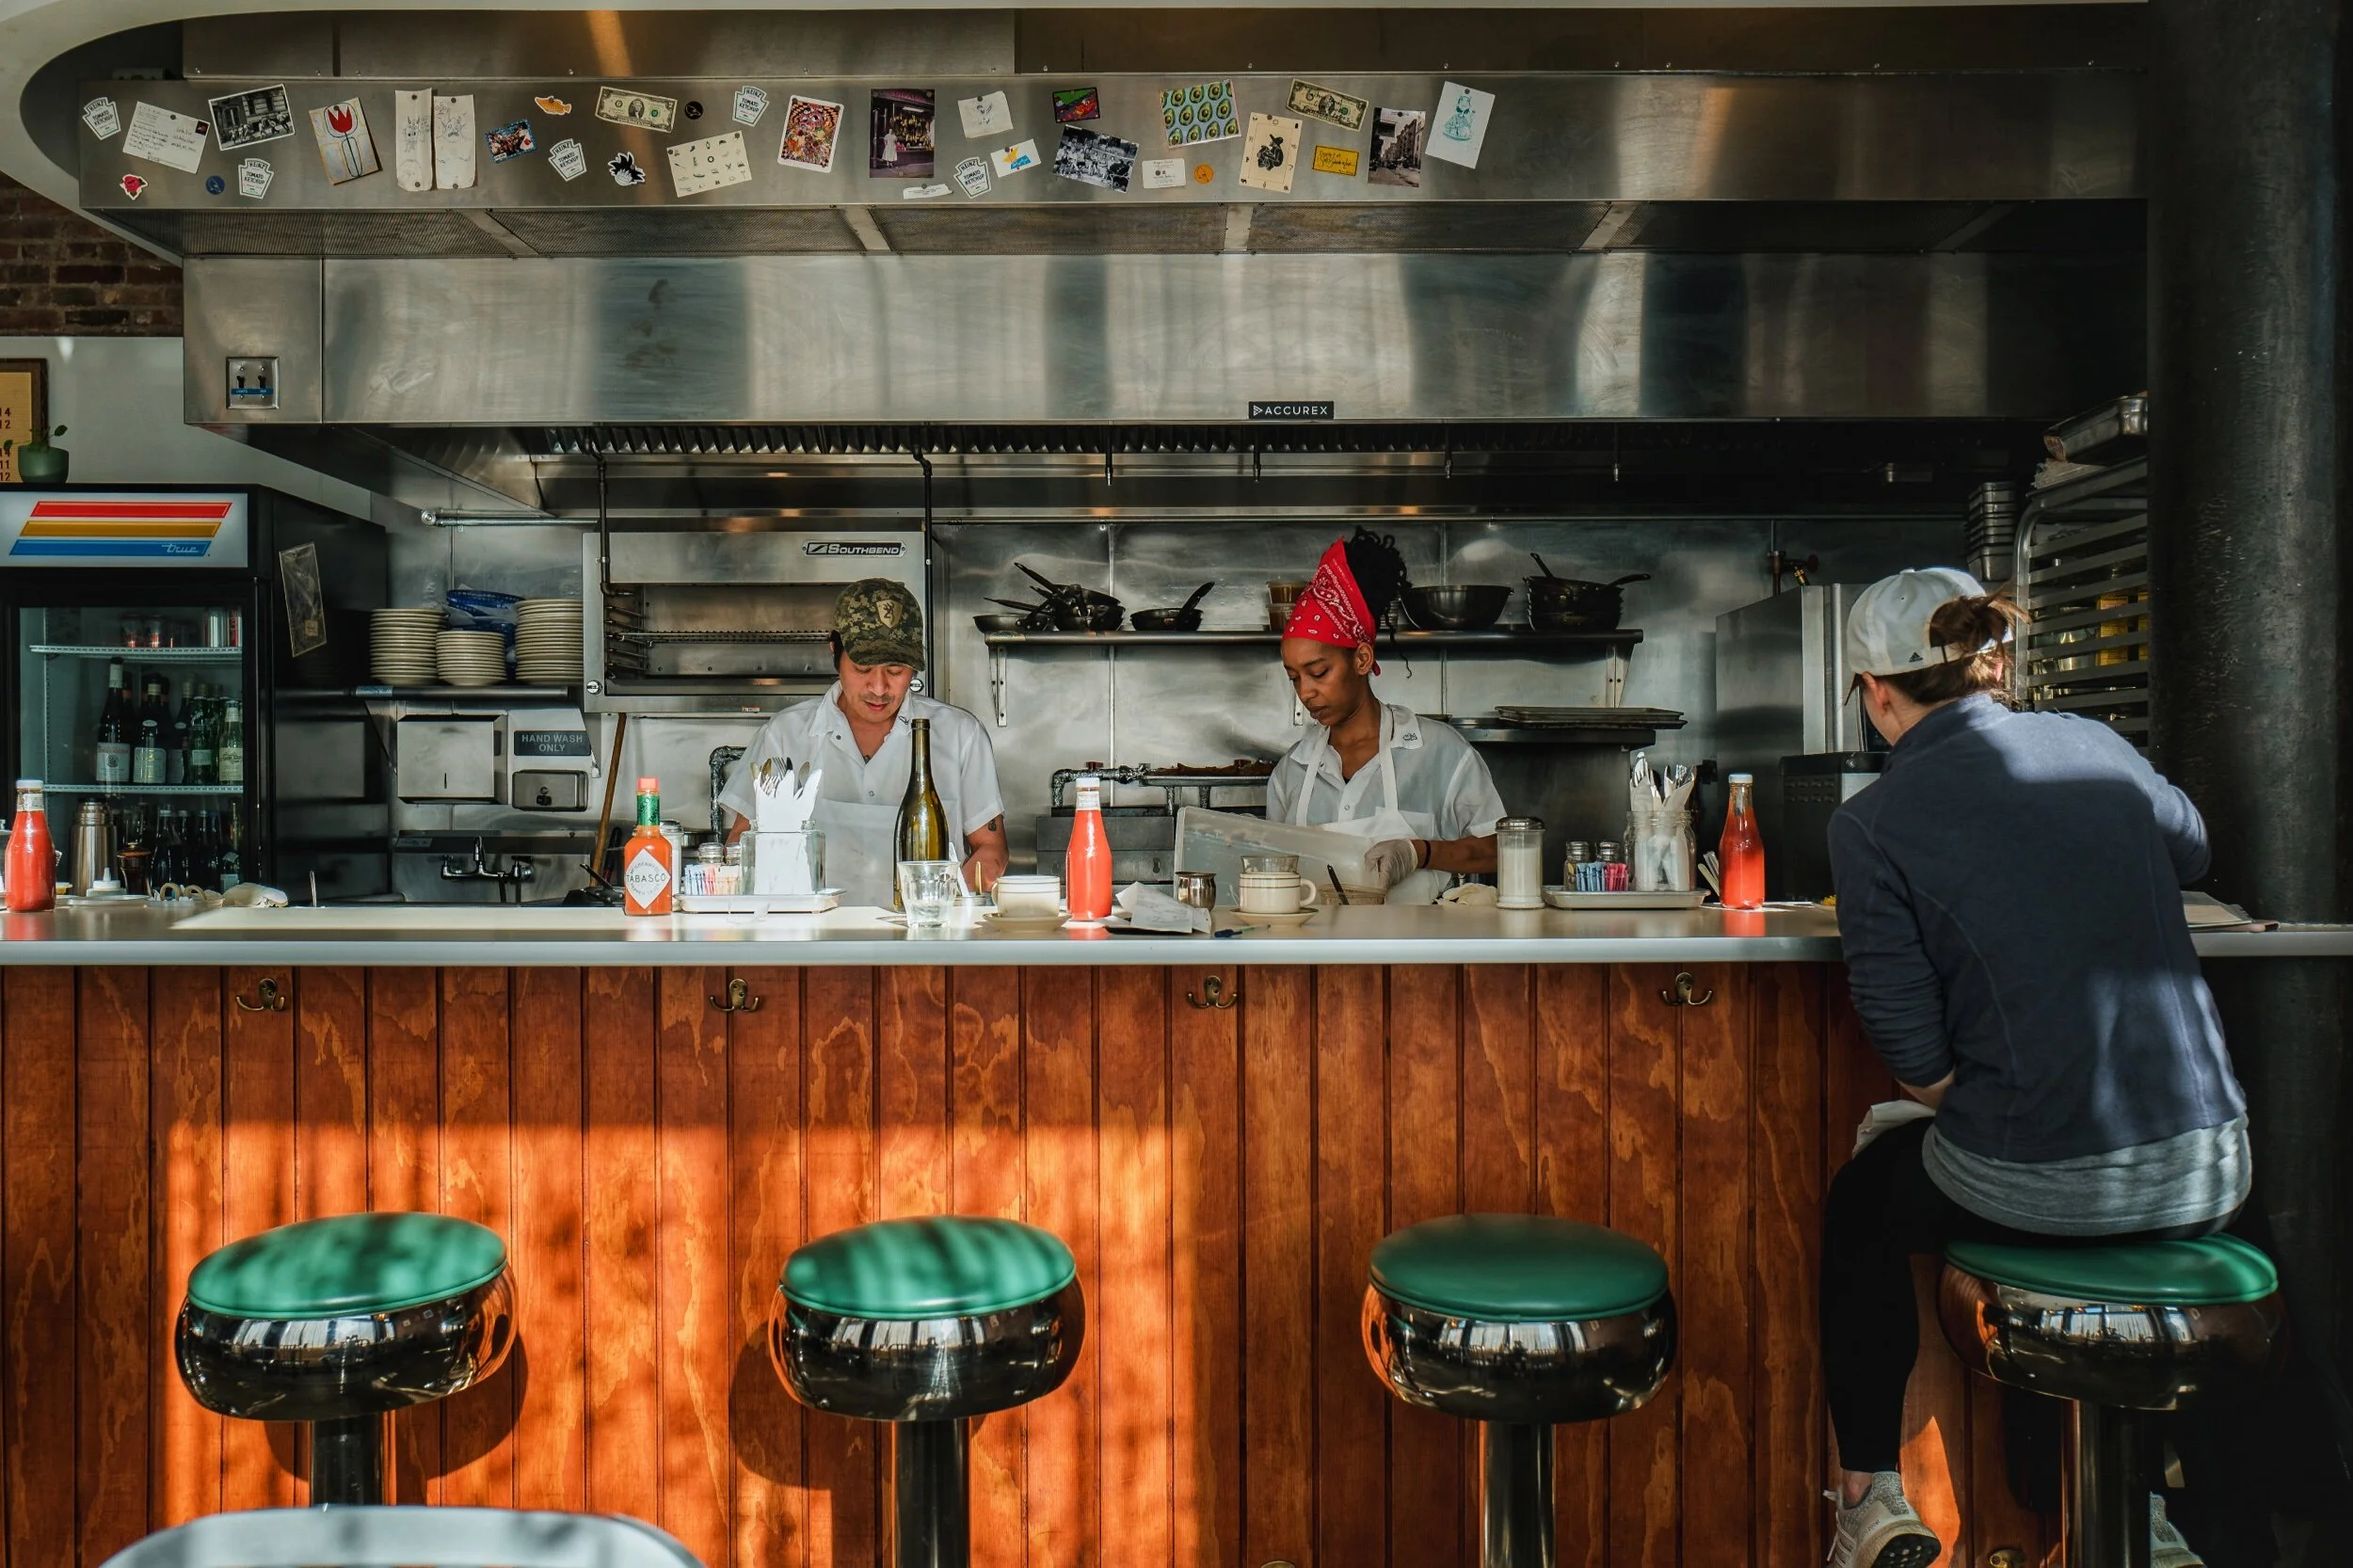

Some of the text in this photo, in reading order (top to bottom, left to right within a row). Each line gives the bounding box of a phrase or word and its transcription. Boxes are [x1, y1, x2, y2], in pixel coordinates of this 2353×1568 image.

[960, 160, 976, 170] HEINZ
[1264, 406, 1328, 415] ACCUREX
[521, 734, 583, 743] HAND WASH
[538, 744, 566, 752] ONLY
[626, 872, 666, 883] TABASCO
